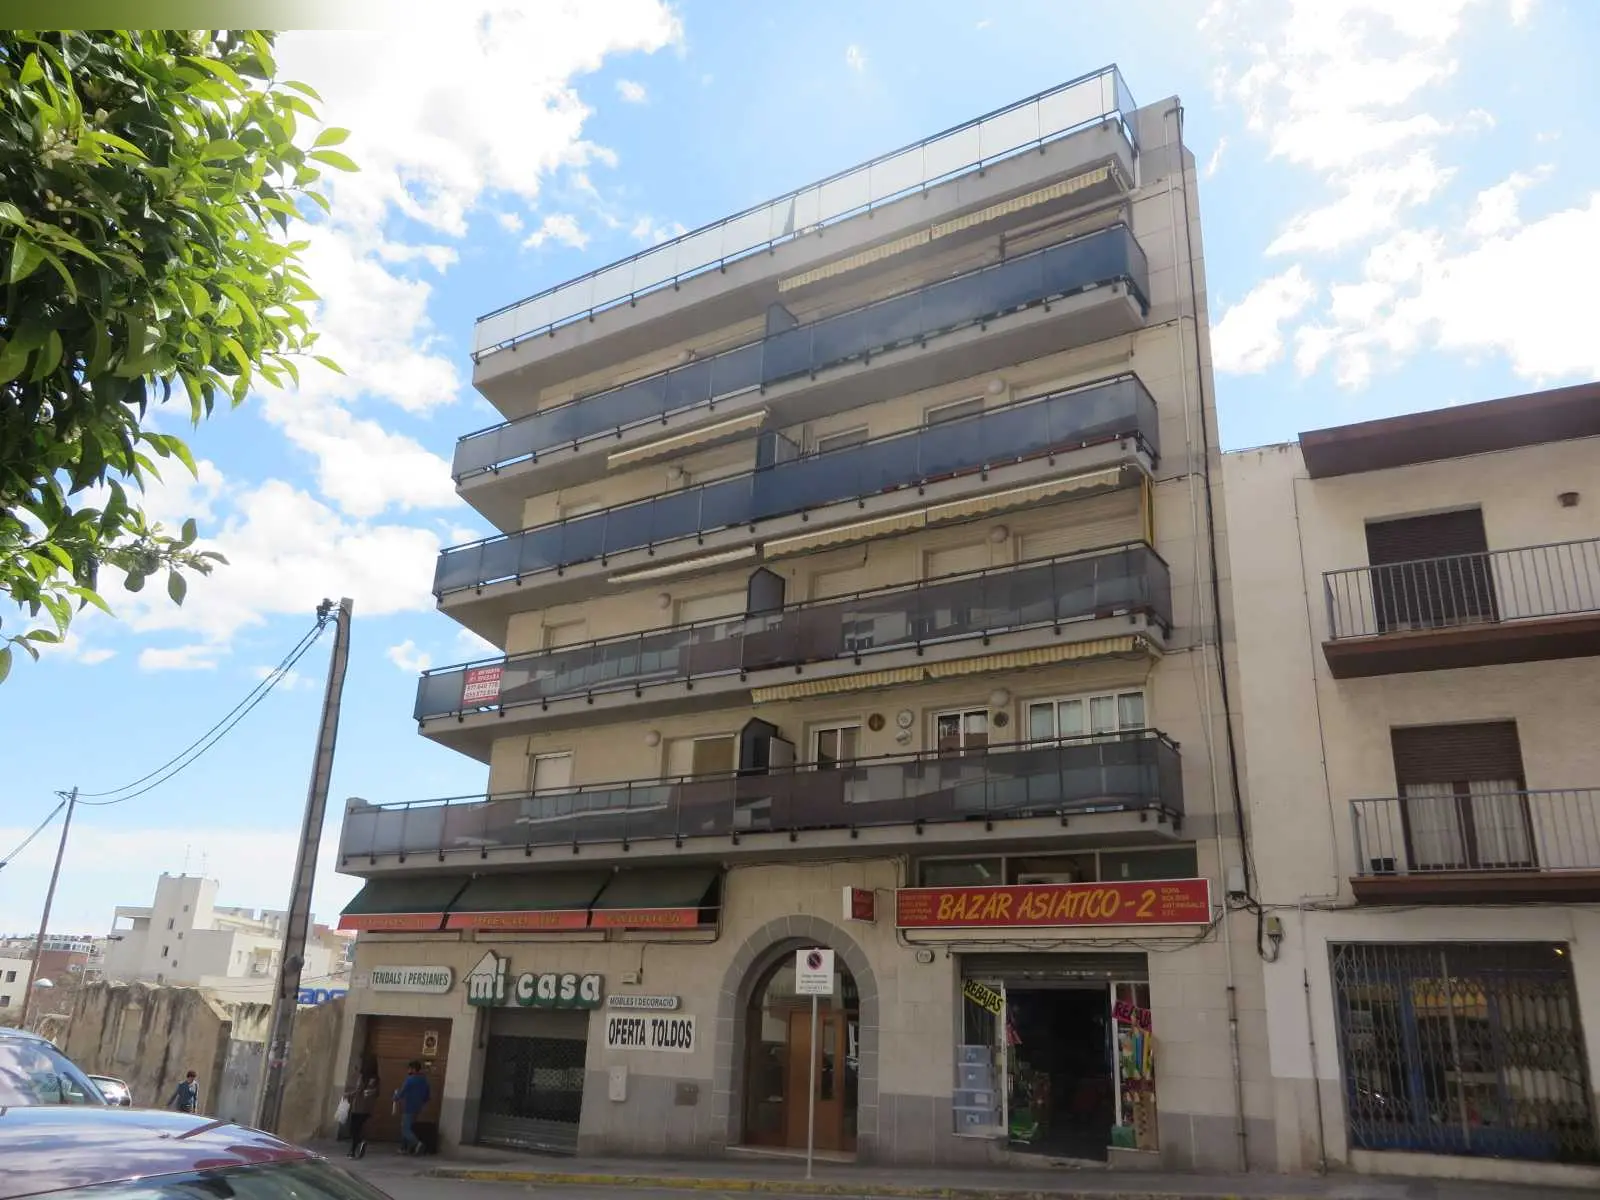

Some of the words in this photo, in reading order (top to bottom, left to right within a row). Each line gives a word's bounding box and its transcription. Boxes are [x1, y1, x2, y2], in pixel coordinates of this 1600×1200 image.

[372, 971, 402, 985] TENDALS
[408, 972, 449, 986] PERSIANES
[516, 972, 603, 1003] casa
[964, 979, 1004, 1012] REBAJAS
[608, 1017, 646, 1046] OFERTA
[651, 1018, 692, 1049] TOLDOS
